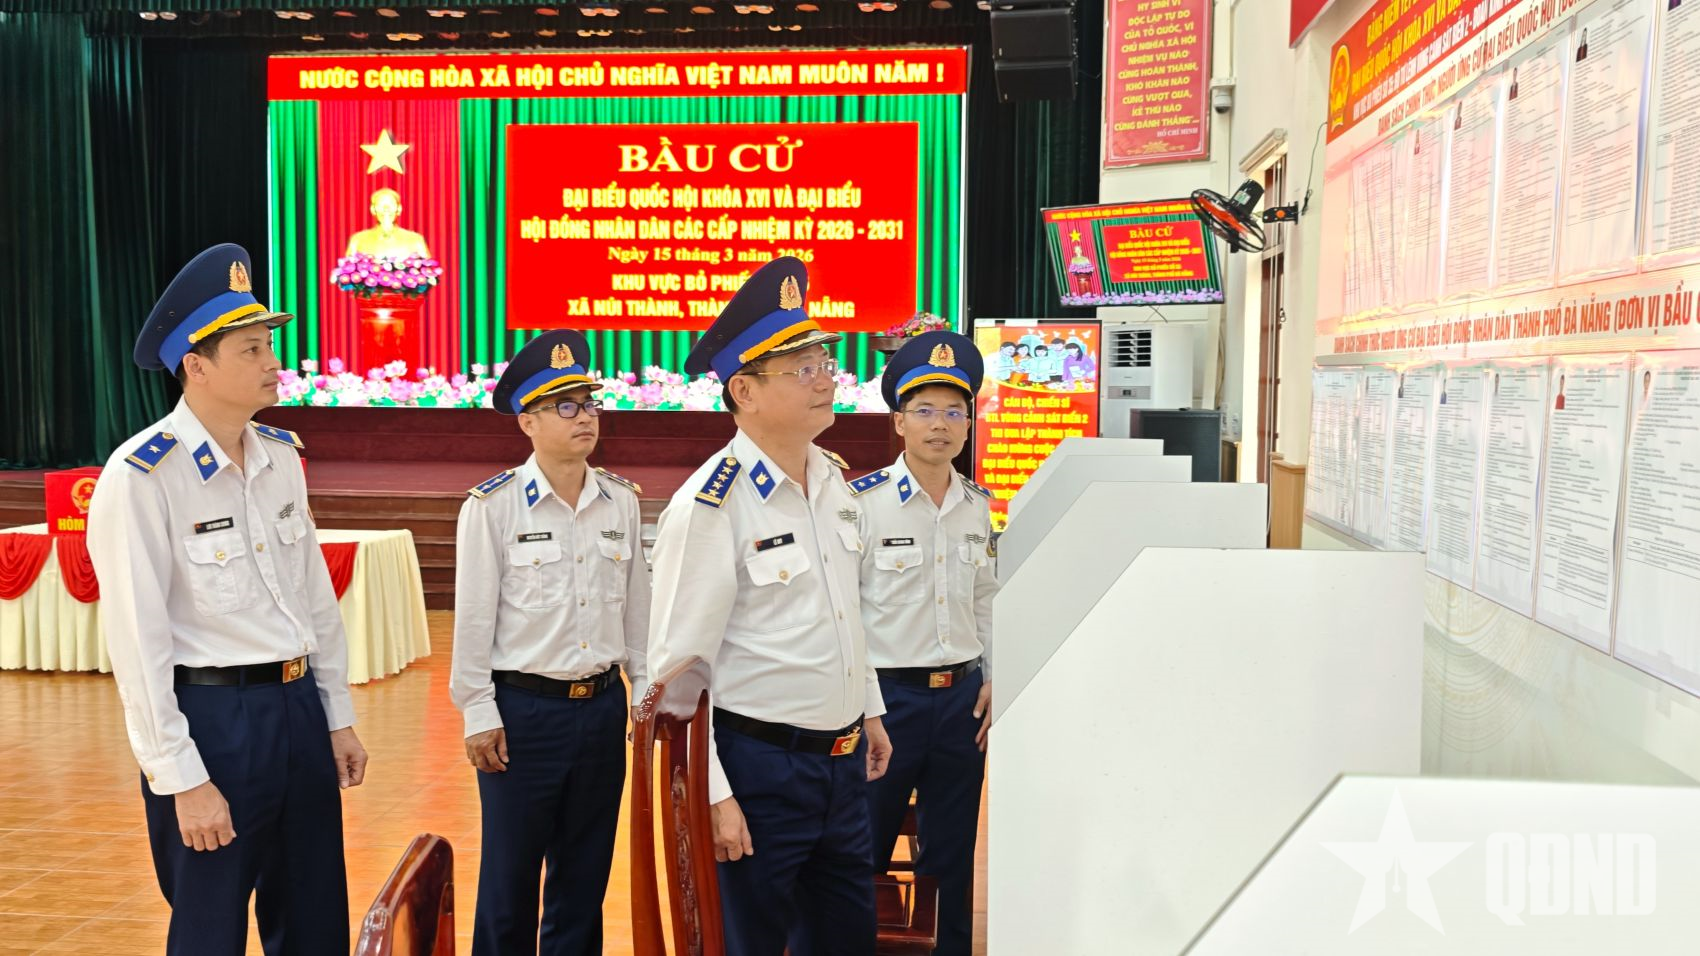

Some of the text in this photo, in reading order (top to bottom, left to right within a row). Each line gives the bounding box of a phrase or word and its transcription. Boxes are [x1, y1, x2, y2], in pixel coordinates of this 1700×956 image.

[1138, 2, 1149, 12] HY
[1178, 10, 1190, 18] DO
[1422, 2, 1435, 37] XVI
[1498, 16, 1515, 56] BIỂU
[1516, 0, 1538, 45] QUỐC
[300, 60, 944, 92] NƯỚC CỘNG HÒA XÃ HỘI CHỦ NGHĨA VIỆT NAM MUÔN NĂM !
[1157, 128, 1166, 137] HỒ
[1168, 128, 1180, 136] CHÍ
[618, 136, 804, 172] BẦU CỬ
[562, 180, 862, 212] ĐẠI BIỂU QUỐC HỘI KHÓA XVI VÀ ĐẠI BIỂU
[520, 215, 546, 243] HỘI
[549, 213, 590, 239] ĐỒNG
[593, 216, 636, 239] NHÂN
[638, 216, 670, 240] DÂN
[673, 216, 704, 240] CÁC
[706, 214, 738, 240] CẤP
[740, 216, 790, 244] NHIỆM
[794, 216, 814, 240] KỲ
[817, 220, 854, 240] 2026
[867, 220, 904, 240] 2031
[608, 246, 648, 264] Ngày
[654, 248, 672, 261] 15
[675, 247, 720, 264] tháng
[723, 248, 734, 262] 3
[738, 248, 772, 262] năm
[612, 269, 751, 294] KHU VỰC BỎ PHIẾ
[567, 296, 590, 316] XÃ
[593, 296, 622, 316] NÚI
[626, 296, 684, 318] THÀNH,
[808, 296, 855, 318] NẴNG
[1472, 313, 1494, 342] NHÂN
[1495, 310, 1511, 340] DÂN
[1513, 308, 1541, 338] THÀNH
[1542, 298, 1562, 336] PHỐ
[1564, 300, 1578, 335] ĐÀ
[1580, 292, 1611, 333] NẴNG
[1614, 295, 1644, 334] (ĐƠN
[1648, 294, 1660, 335] VỊ
[1663, 280, 1692, 327] BẦU
[58, 516, 85, 531] HÒM
